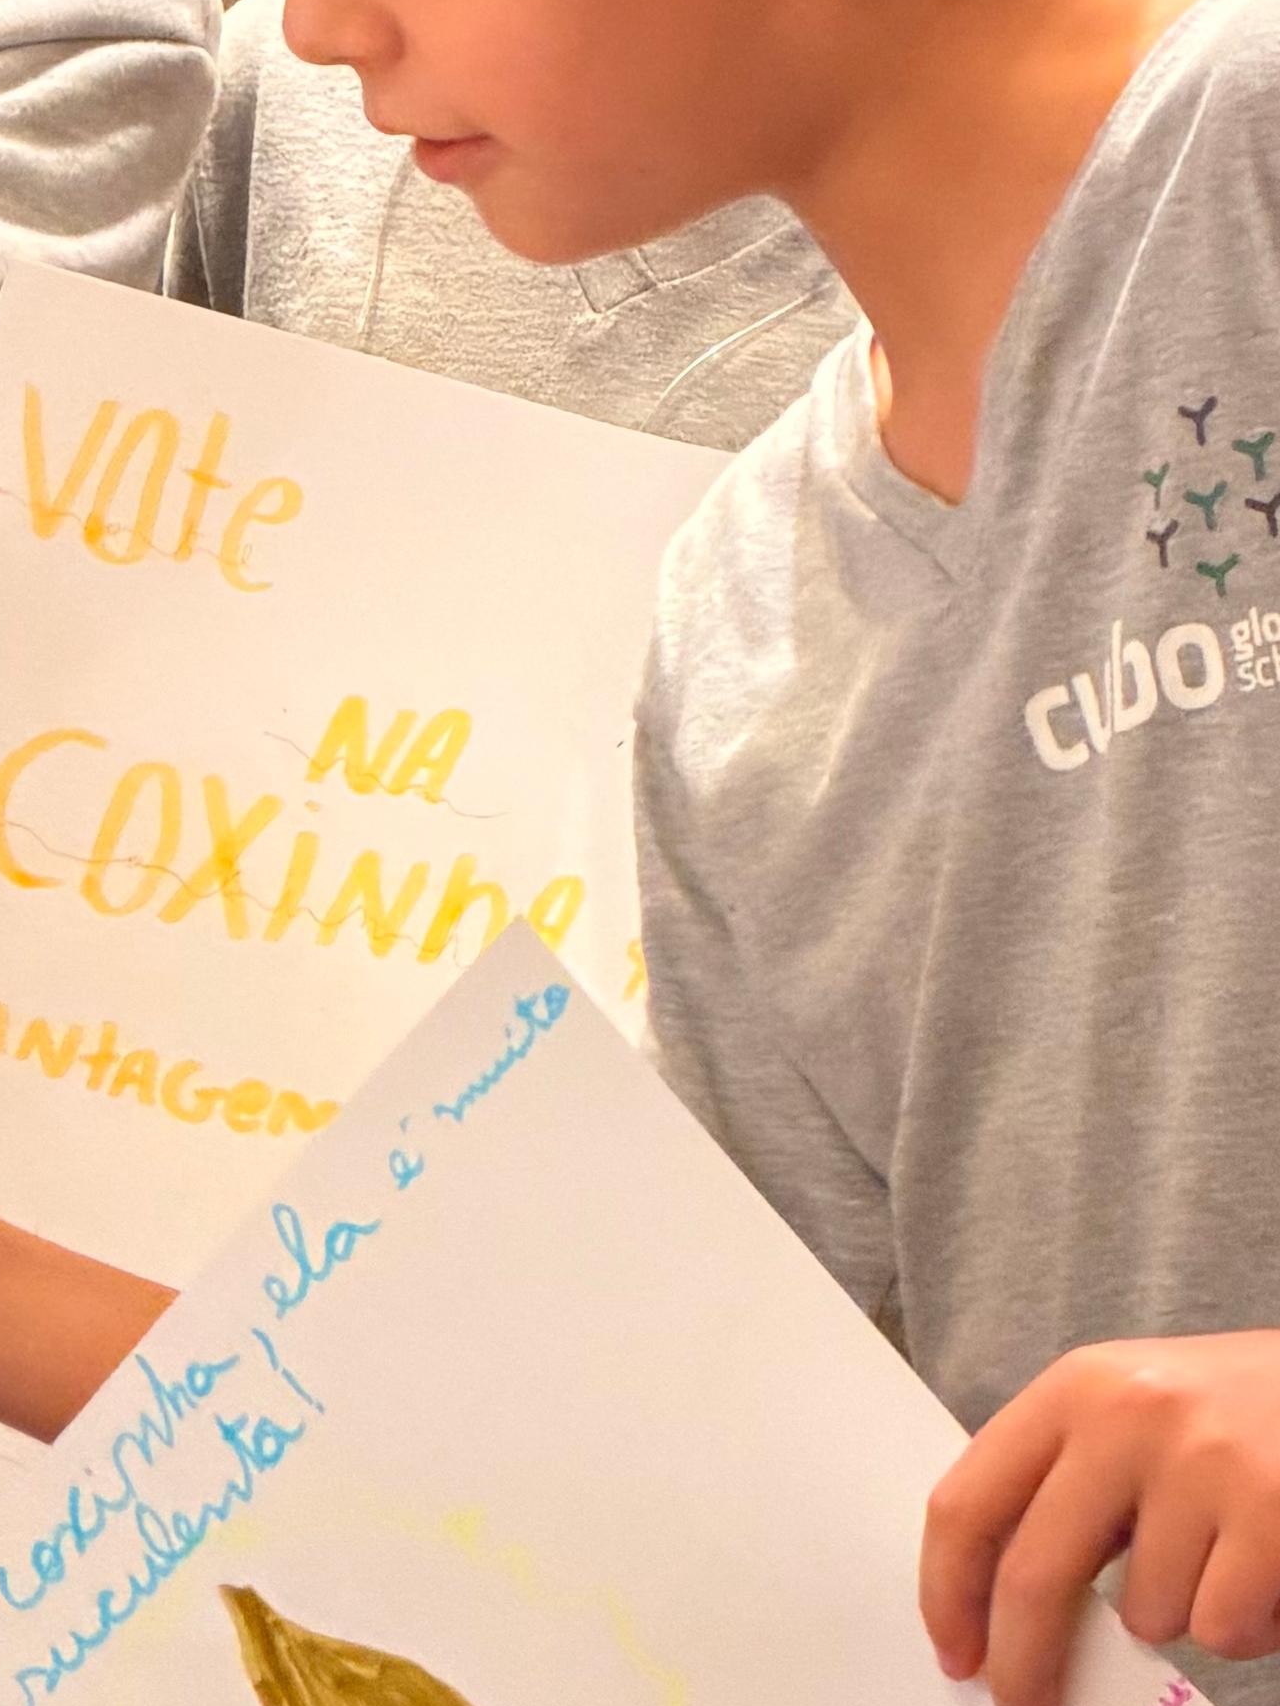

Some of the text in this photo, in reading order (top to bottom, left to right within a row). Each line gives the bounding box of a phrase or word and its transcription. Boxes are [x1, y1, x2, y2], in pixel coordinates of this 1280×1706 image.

[306, 694, 473, 805] NA
[262, 1204, 379, 1319] ela
[433, 982, 570, 1123] muito
